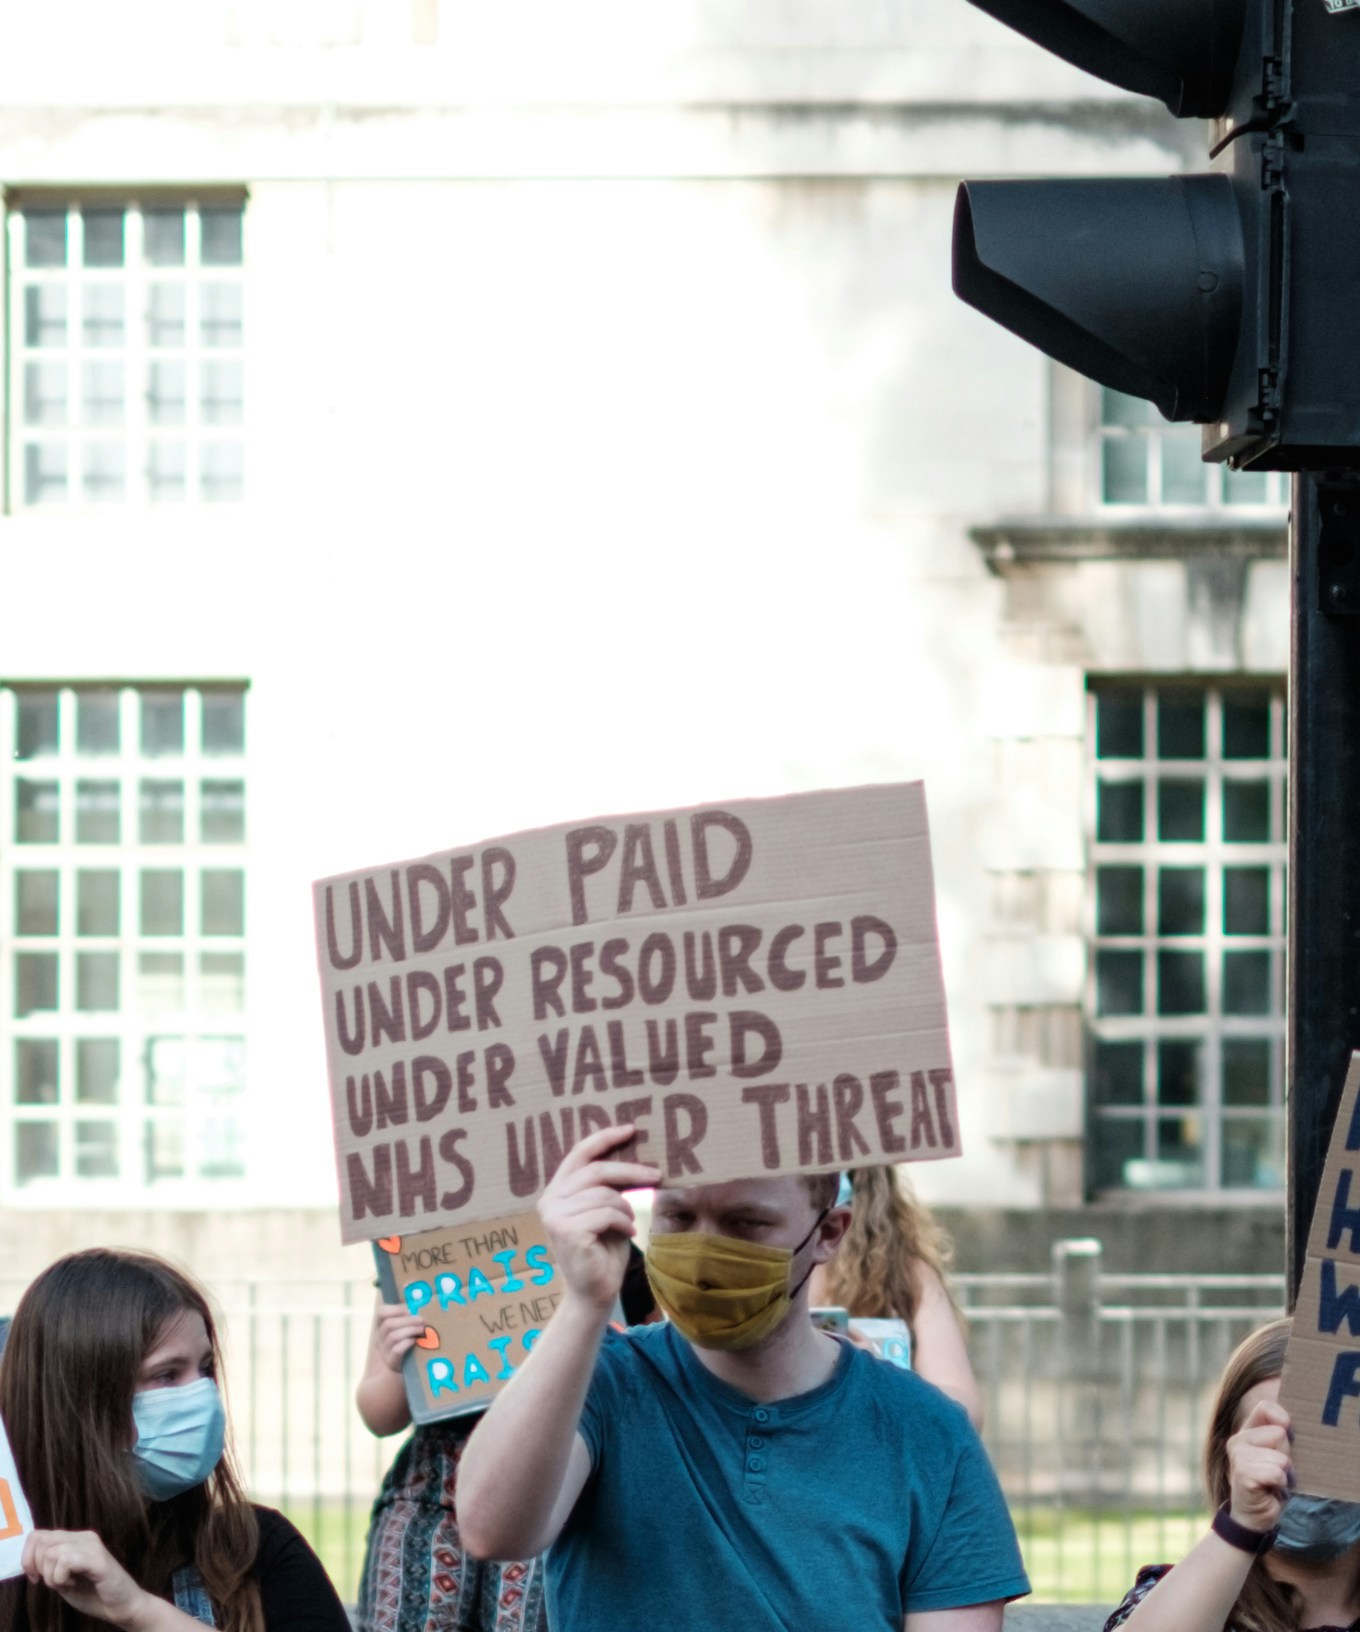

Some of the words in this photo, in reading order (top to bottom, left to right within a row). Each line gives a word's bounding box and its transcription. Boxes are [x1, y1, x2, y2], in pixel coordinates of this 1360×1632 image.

[325, 846, 517, 971] UNDER
[565, 810, 753, 927] PAID
[335, 955, 505, 1056] UNDER
[530, 915, 898, 1022] RESOURCED
[345, 1042, 516, 1137] UNDER
[537, 1010, 783, 1097] VALUED
[345, 1128, 475, 1220] NHS
[742, 1067, 956, 1170] THREAT
[400, 1242, 453, 1273] MORE
[459, 1227, 519, 1256] THAN
[403, 1244, 555, 1316] PRAIS
[426, 1328, 542, 1398] RAI
[479, 1303, 518, 1335] WE
